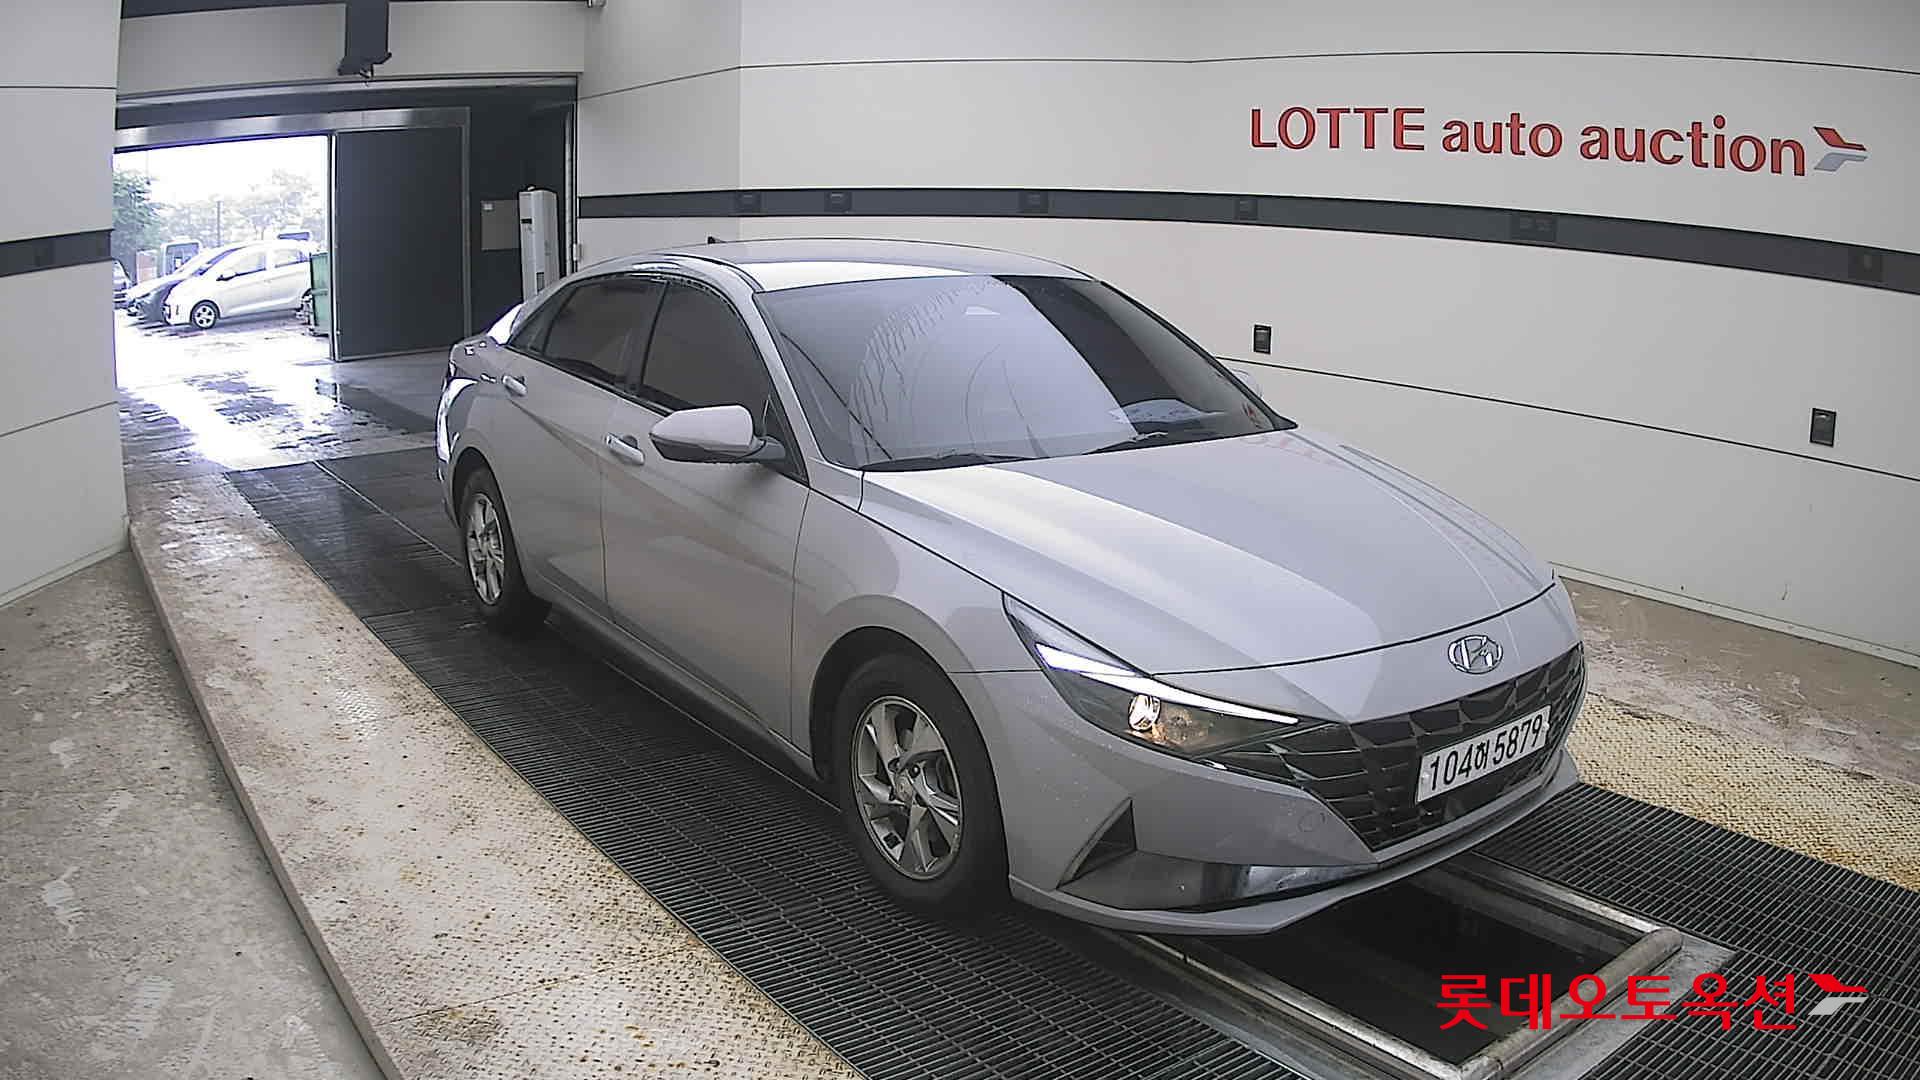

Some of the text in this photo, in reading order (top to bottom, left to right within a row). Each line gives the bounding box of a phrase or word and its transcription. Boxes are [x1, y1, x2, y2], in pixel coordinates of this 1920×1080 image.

[1250, 106, 1806, 176] LOTTE auto auction
[1492, 714, 1543, 764] 5879
